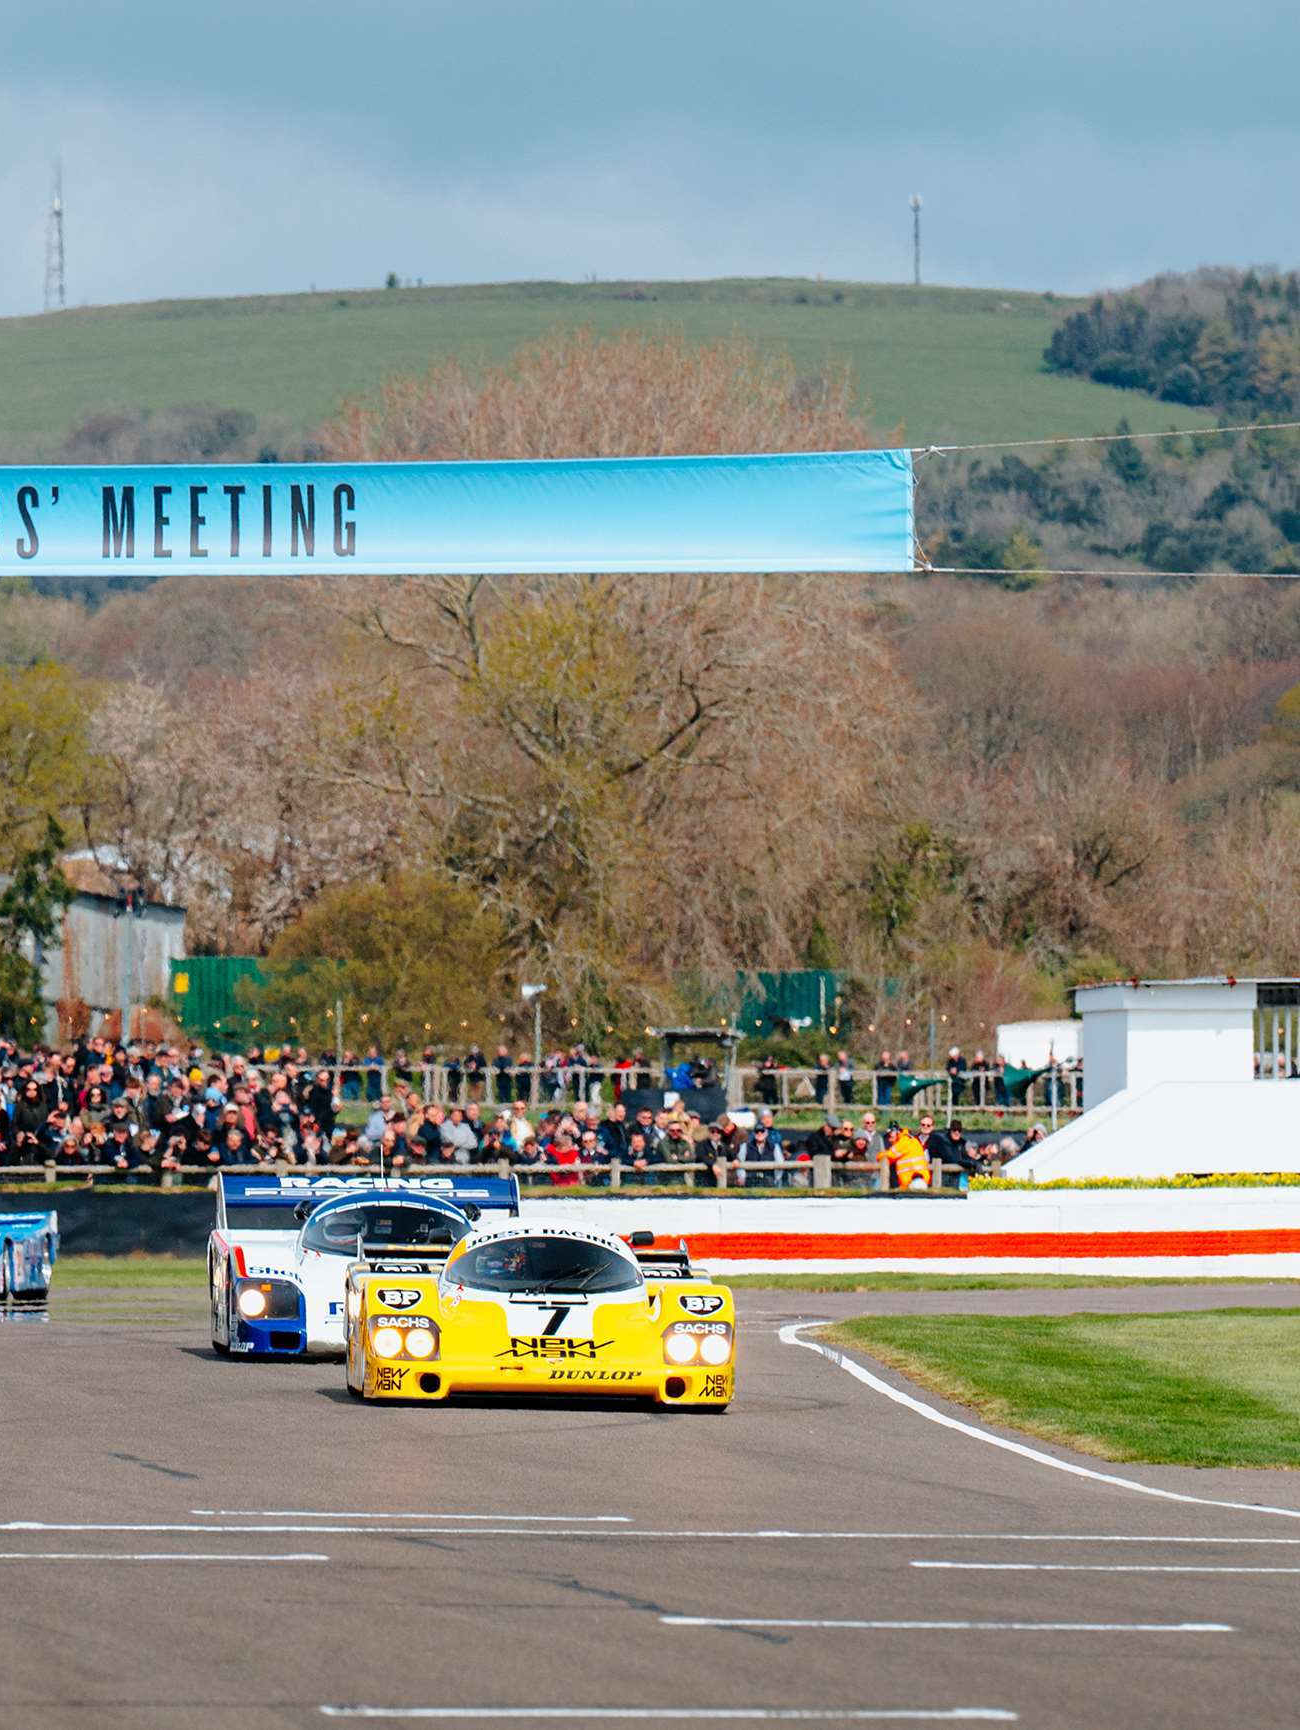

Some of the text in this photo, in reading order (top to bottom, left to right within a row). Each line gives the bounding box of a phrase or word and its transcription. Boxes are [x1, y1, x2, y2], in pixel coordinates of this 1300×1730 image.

[101, 483, 356, 559] MEETING
[279, 1176, 454, 1189] RACING
[467, 1228, 621, 1252] JOEST RACING
[383, 1291, 419, 1305] BP
[684, 1296, 721, 1311] BP
[377, 1316, 430, 1328] SACHS
[538, 1306, 570, 1336] 7
[673, 1322, 727, 1334] SACHS
[548, 1369, 643, 1381] DUNLOP
